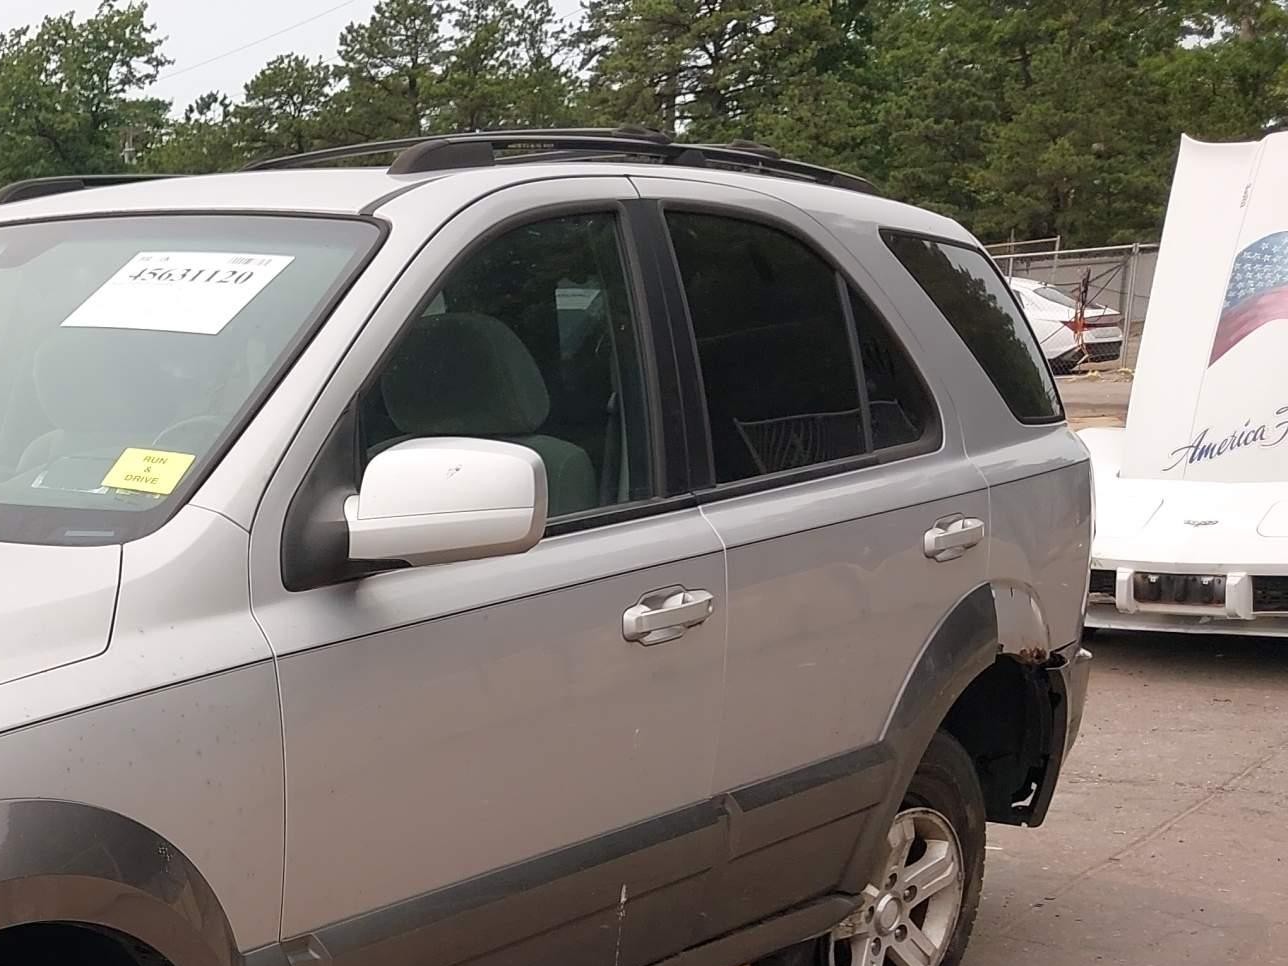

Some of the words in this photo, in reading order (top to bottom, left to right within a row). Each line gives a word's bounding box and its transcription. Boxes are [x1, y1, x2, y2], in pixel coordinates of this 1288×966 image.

[128, 267, 254, 284] 45631120
[1161, 418, 1266, 472] America
[143, 455, 169, 465] RUN
[123, 474, 159, 485] DRIVE
